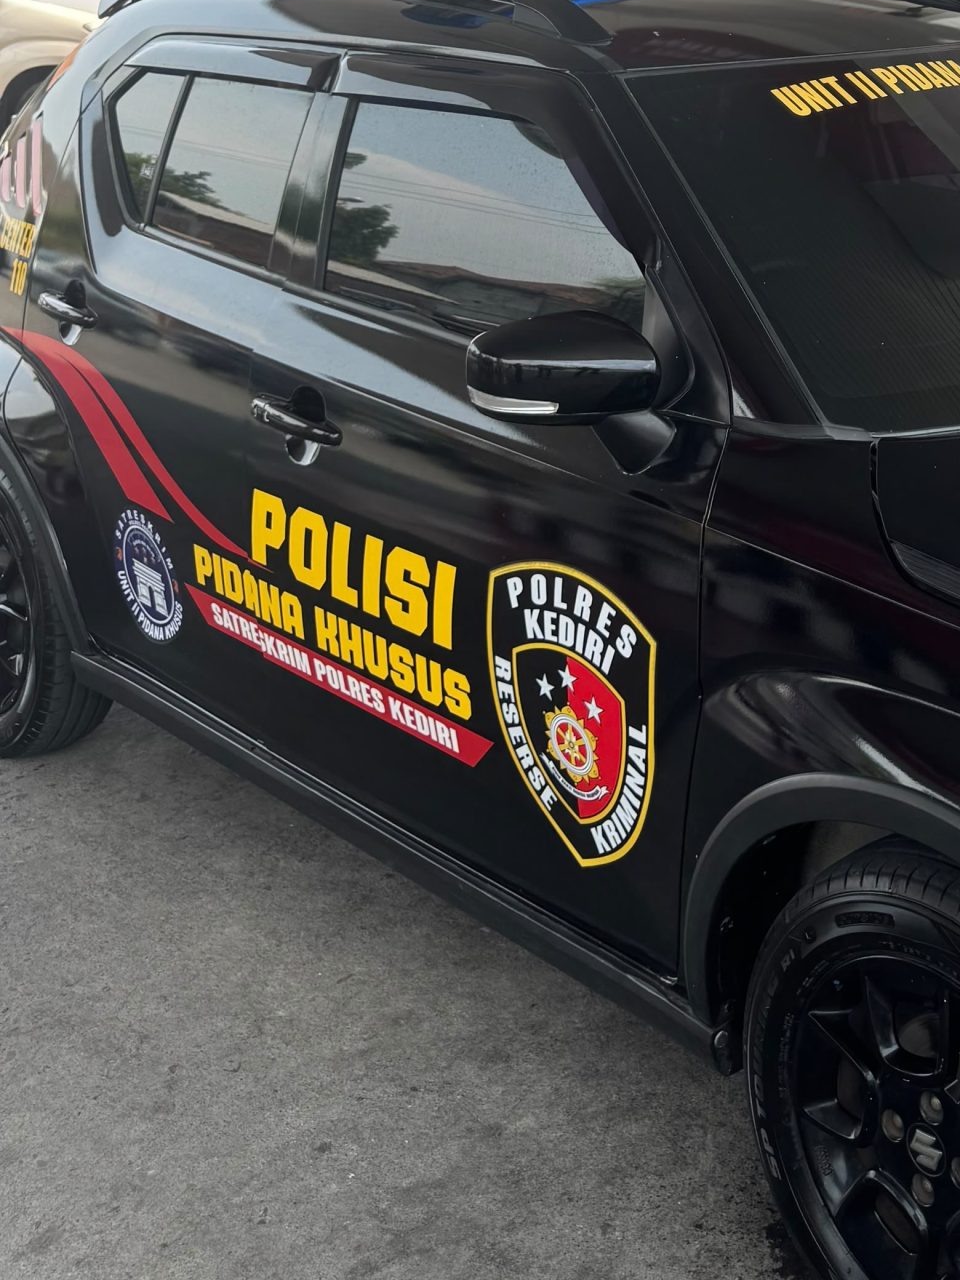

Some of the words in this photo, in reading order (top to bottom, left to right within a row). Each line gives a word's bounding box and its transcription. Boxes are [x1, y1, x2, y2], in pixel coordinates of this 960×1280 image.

[770, 76, 857, 117] UNIT
[844, 71, 888, 100] II
[9, 258, 28, 296] 110
[115, 509, 173, 570] SATRESKRIM
[251, 488, 457, 650] POLISI
[117, 570, 135, 602] UNIT
[137, 612, 164, 640] PIDANA
[164, 600, 183, 640] KHUSUS
[193, 543, 305, 640] PIDANA
[314, 605, 472, 720] KHUSUS
[506, 574, 637, 659] POLRES
[524, 609, 616, 675] KEDIRI
[210, 602, 312, 676] SATRESKRIM
[313, 657, 385, 713] POLRES
[388, 696, 459, 753] KEDIRI
[494, 655, 558, 811] RESERSE
[590, 724, 647, 855] KRIMINAL
